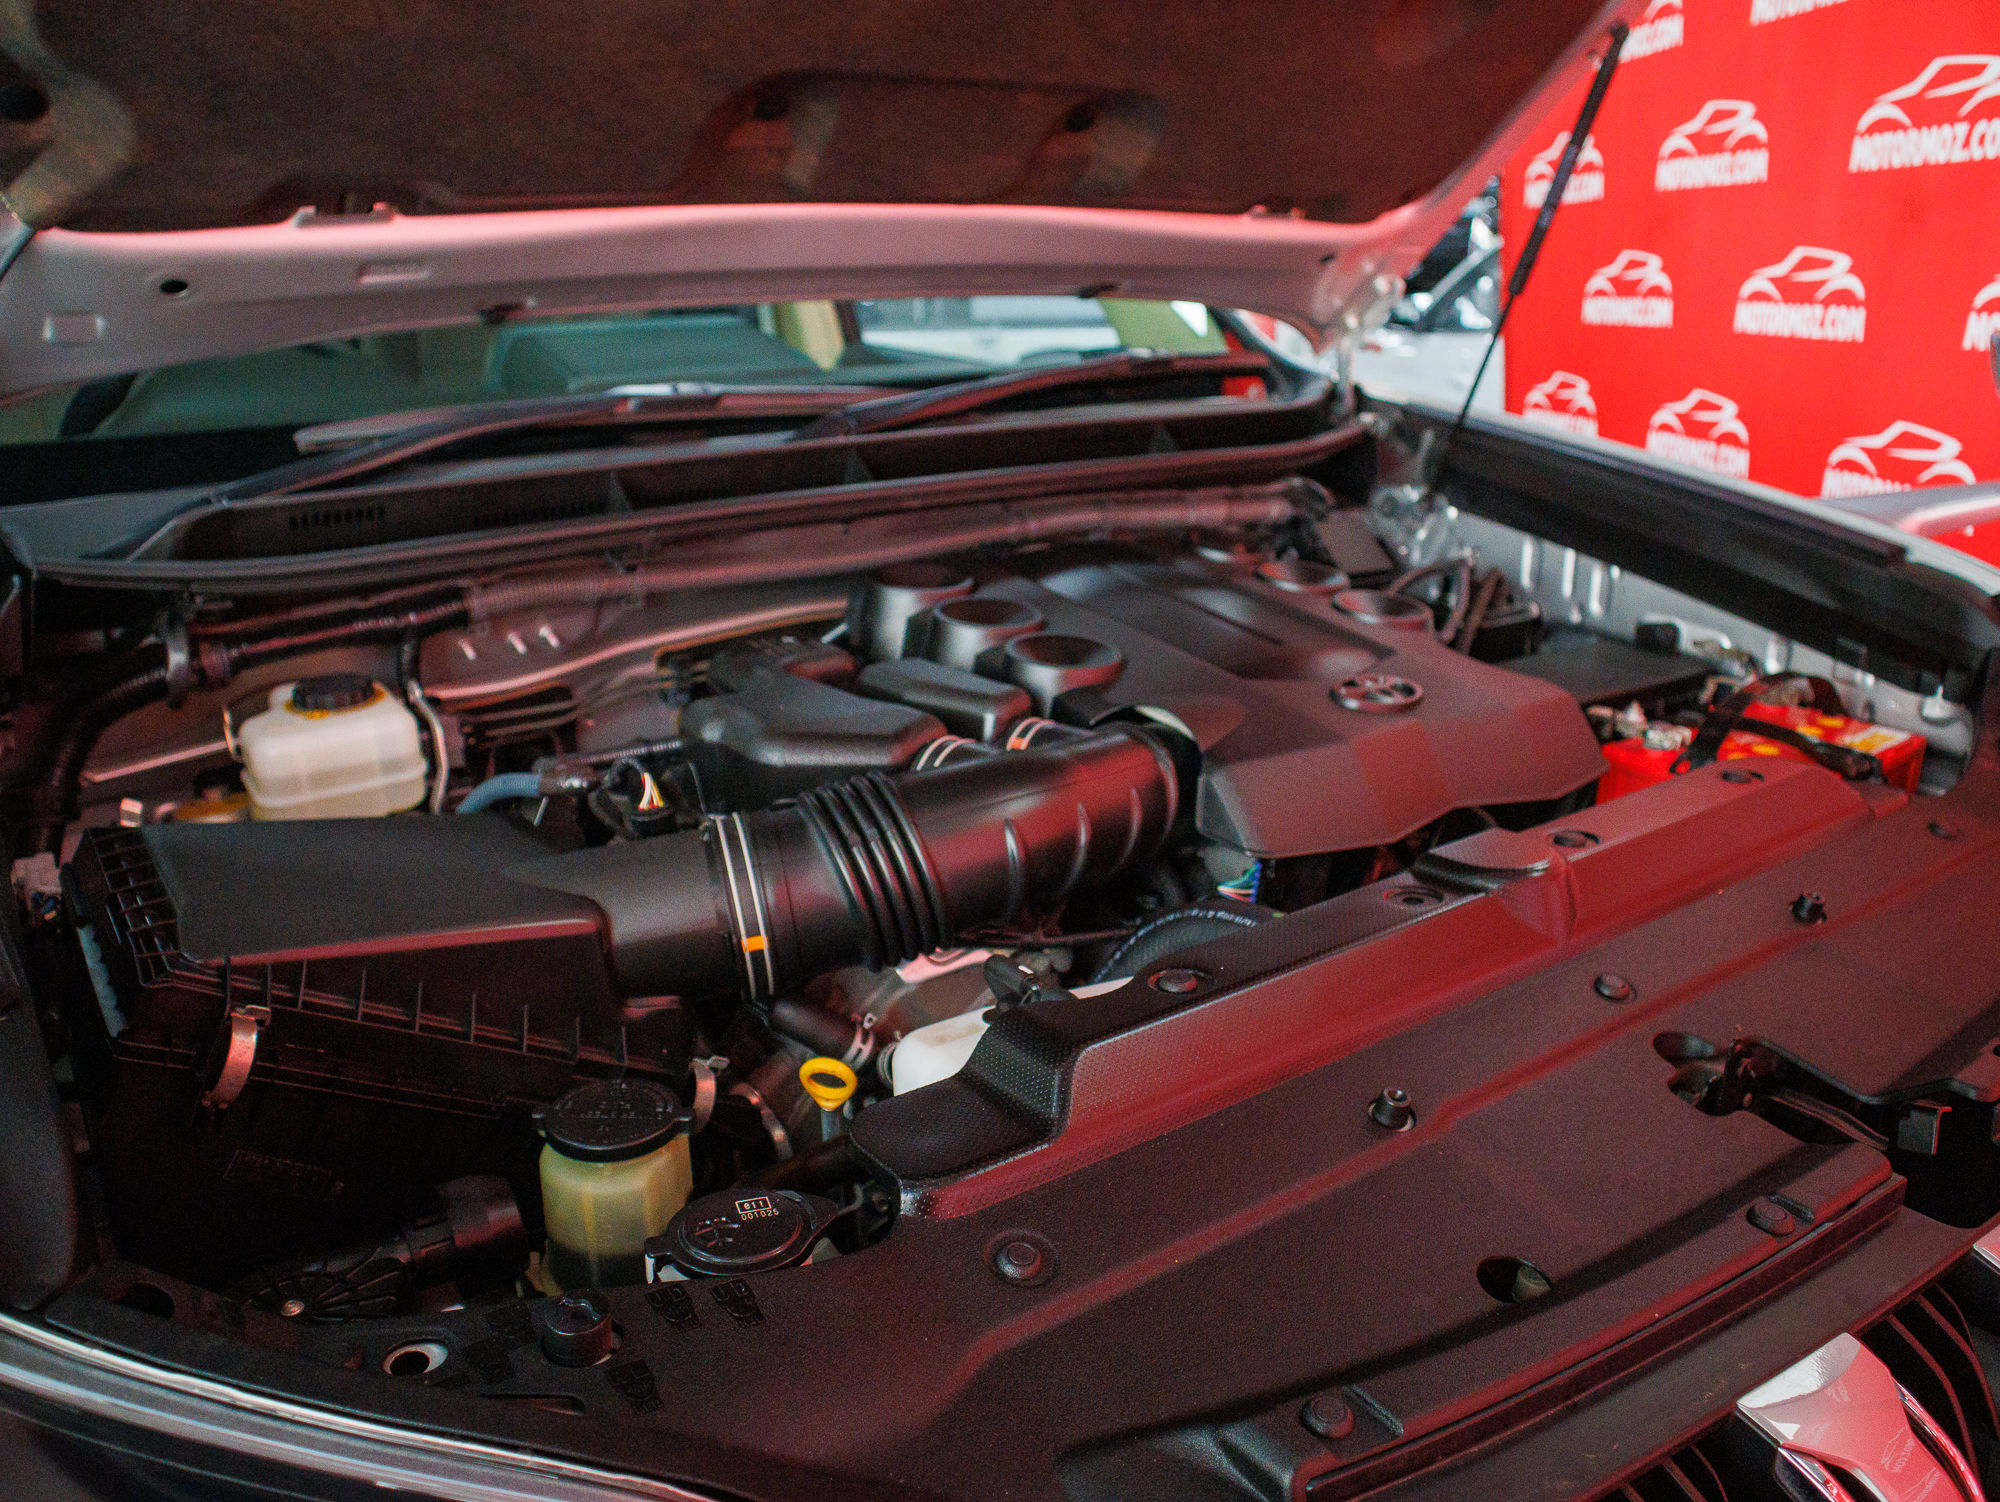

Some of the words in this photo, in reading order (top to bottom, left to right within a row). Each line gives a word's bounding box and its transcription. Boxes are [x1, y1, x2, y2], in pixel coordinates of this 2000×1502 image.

[1654, 147, 1769, 192] MOTORMOZ.COM
[1733, 299, 1866, 343] MOTORMOZ.COM
[741, 1208, 780, 1220] 001025
